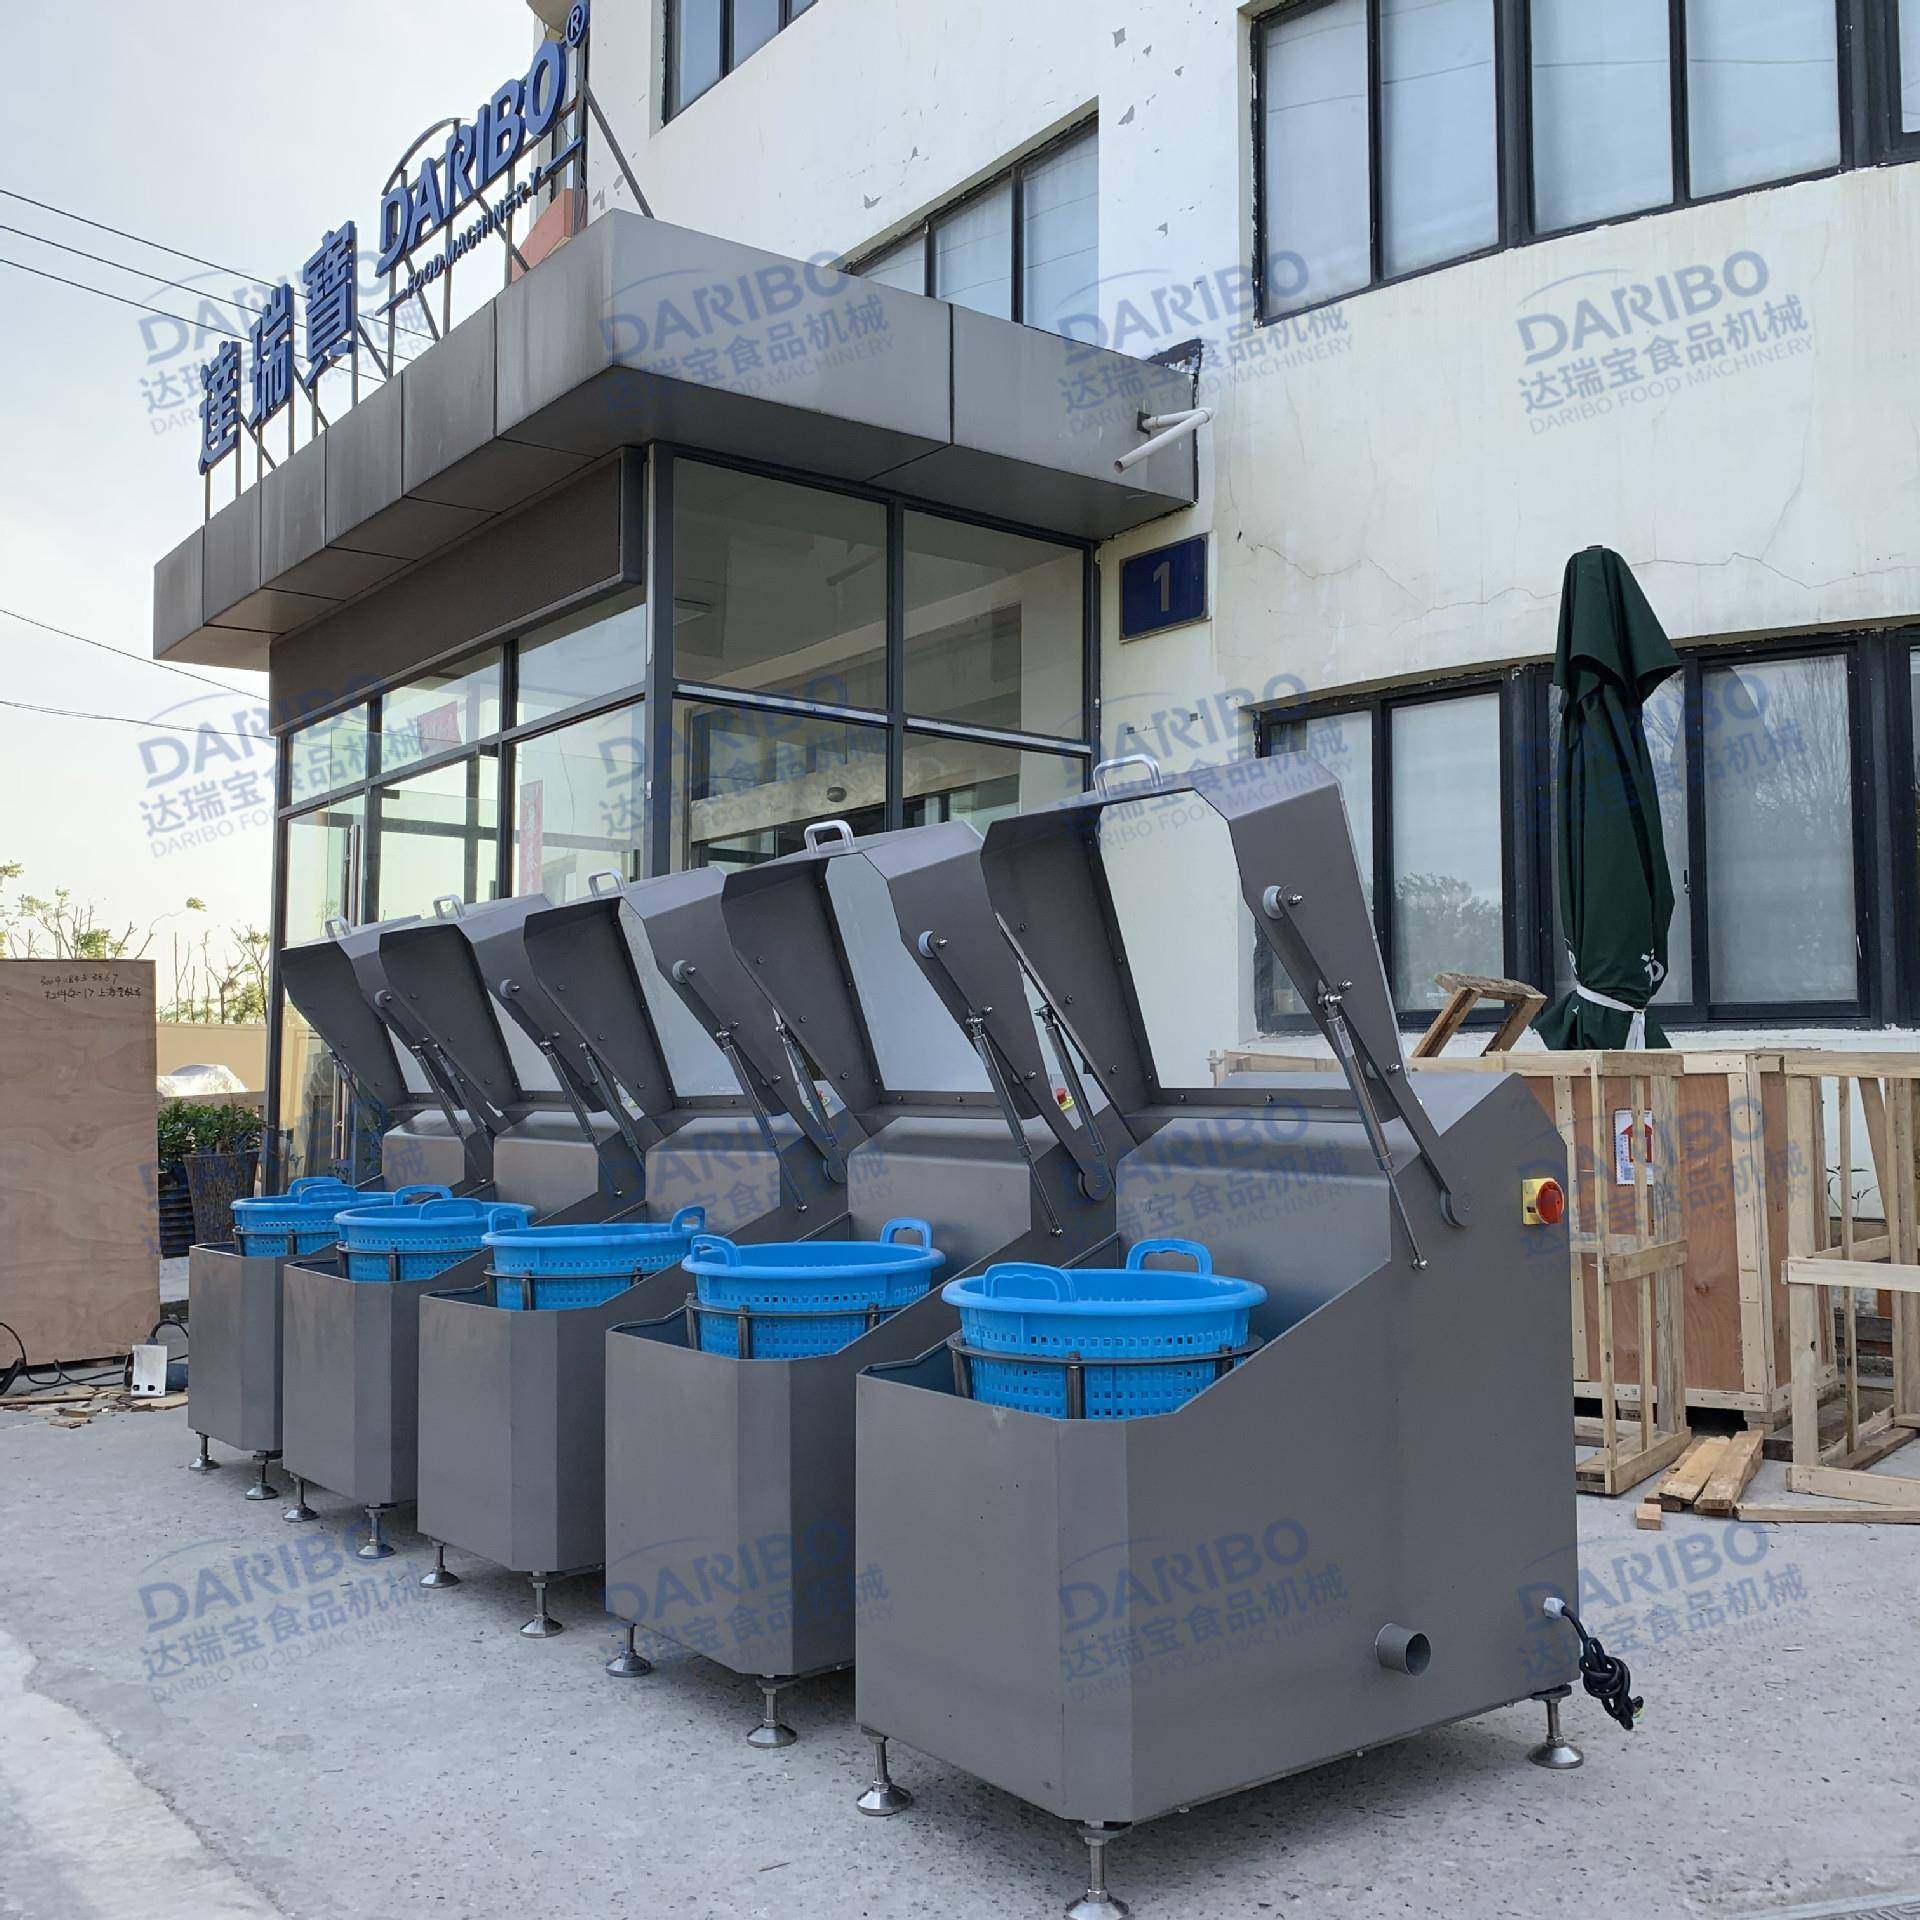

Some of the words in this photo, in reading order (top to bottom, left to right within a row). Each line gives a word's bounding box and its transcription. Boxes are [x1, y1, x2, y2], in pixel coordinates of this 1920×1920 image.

[406, 254, 445, 298] FOOD
[444, 166, 541, 268] MACHINERY
[198, 219, 356, 475] 達瑞寶
[1153, 561, 1170, 612] 1
